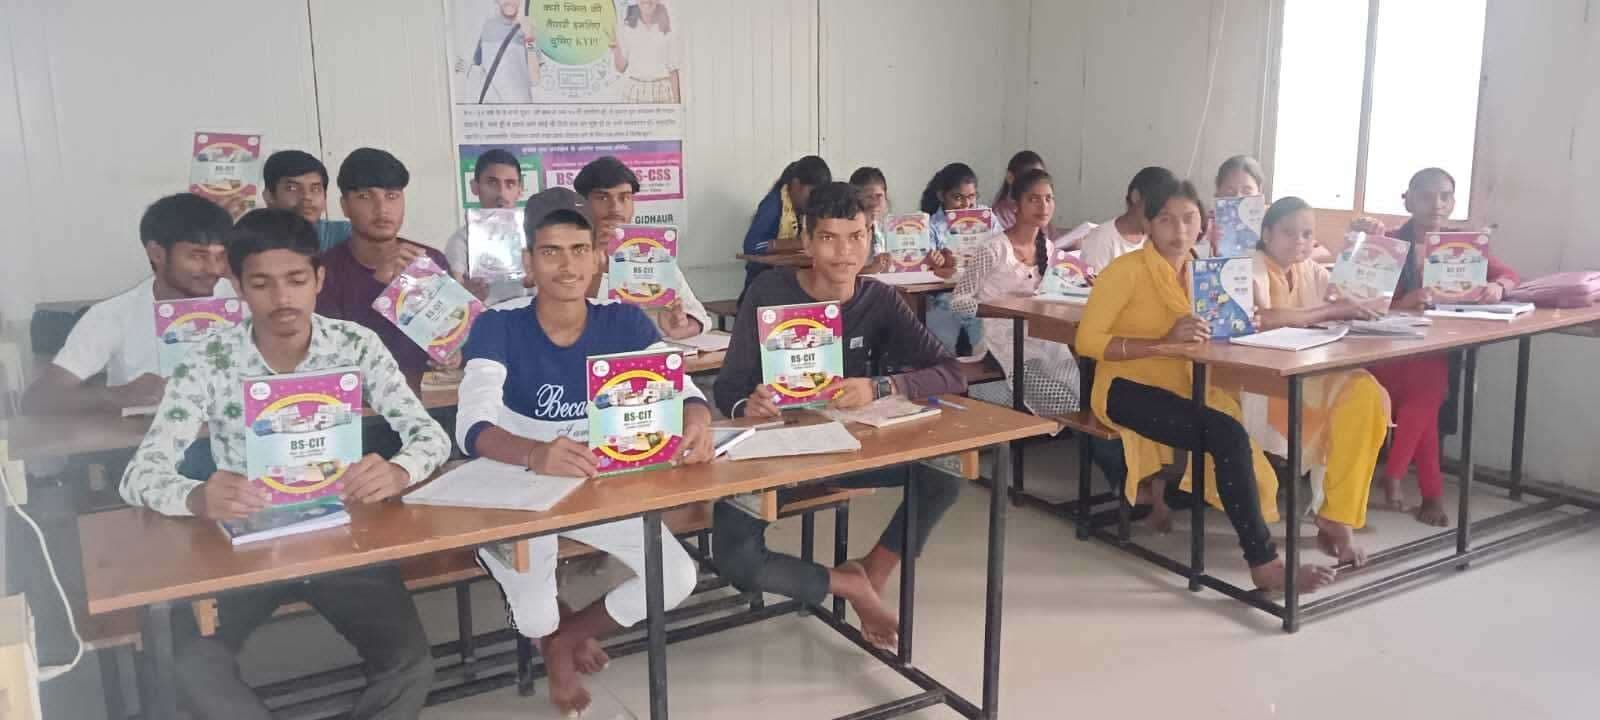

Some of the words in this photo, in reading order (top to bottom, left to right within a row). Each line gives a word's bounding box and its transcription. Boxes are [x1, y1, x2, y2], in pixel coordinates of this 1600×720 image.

[634, 167, 671, 182] S-CSS
[634, 213, 674, 225] GIDHAUR
[790, 352, 816, 363] BS-CIT
[535, 384, 588, 418] Beca
[623, 409, 652, 422] BS-CIT
[290, 436, 326, 450] BS-CIT
